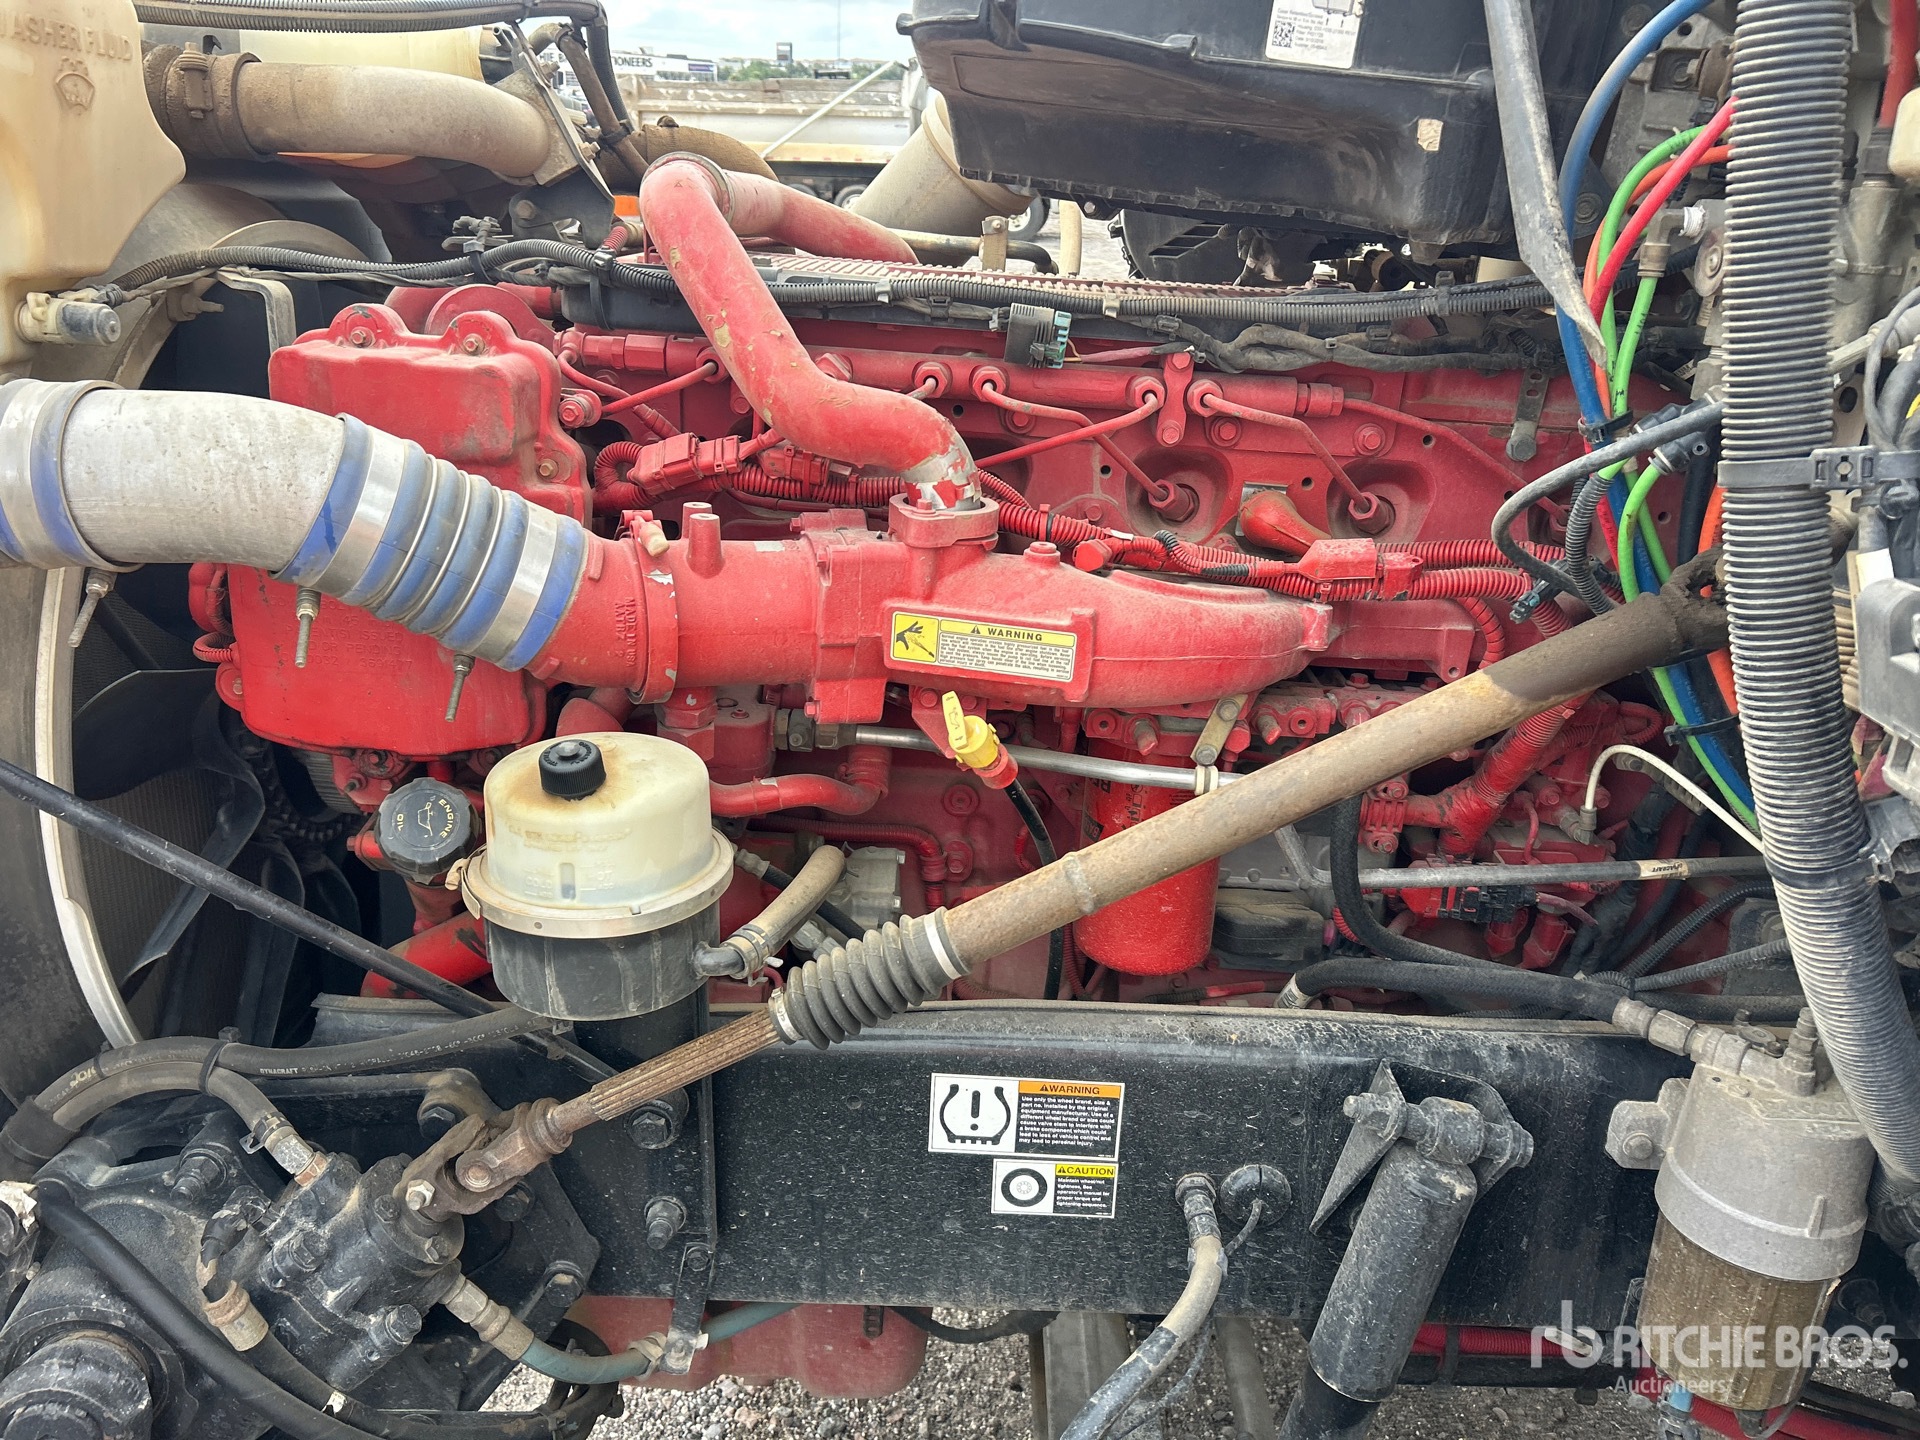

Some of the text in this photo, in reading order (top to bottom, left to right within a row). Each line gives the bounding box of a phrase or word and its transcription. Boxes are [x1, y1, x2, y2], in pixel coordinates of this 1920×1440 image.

[84, 27, 134, 62] FLUID
[988, 627, 1043, 642] WARNING
[396, 798, 455, 839] OIL ENGINE
[1049, 1084, 1100, 1095] WARNING
[1066, 1166, 1114, 1176] CAUTION
